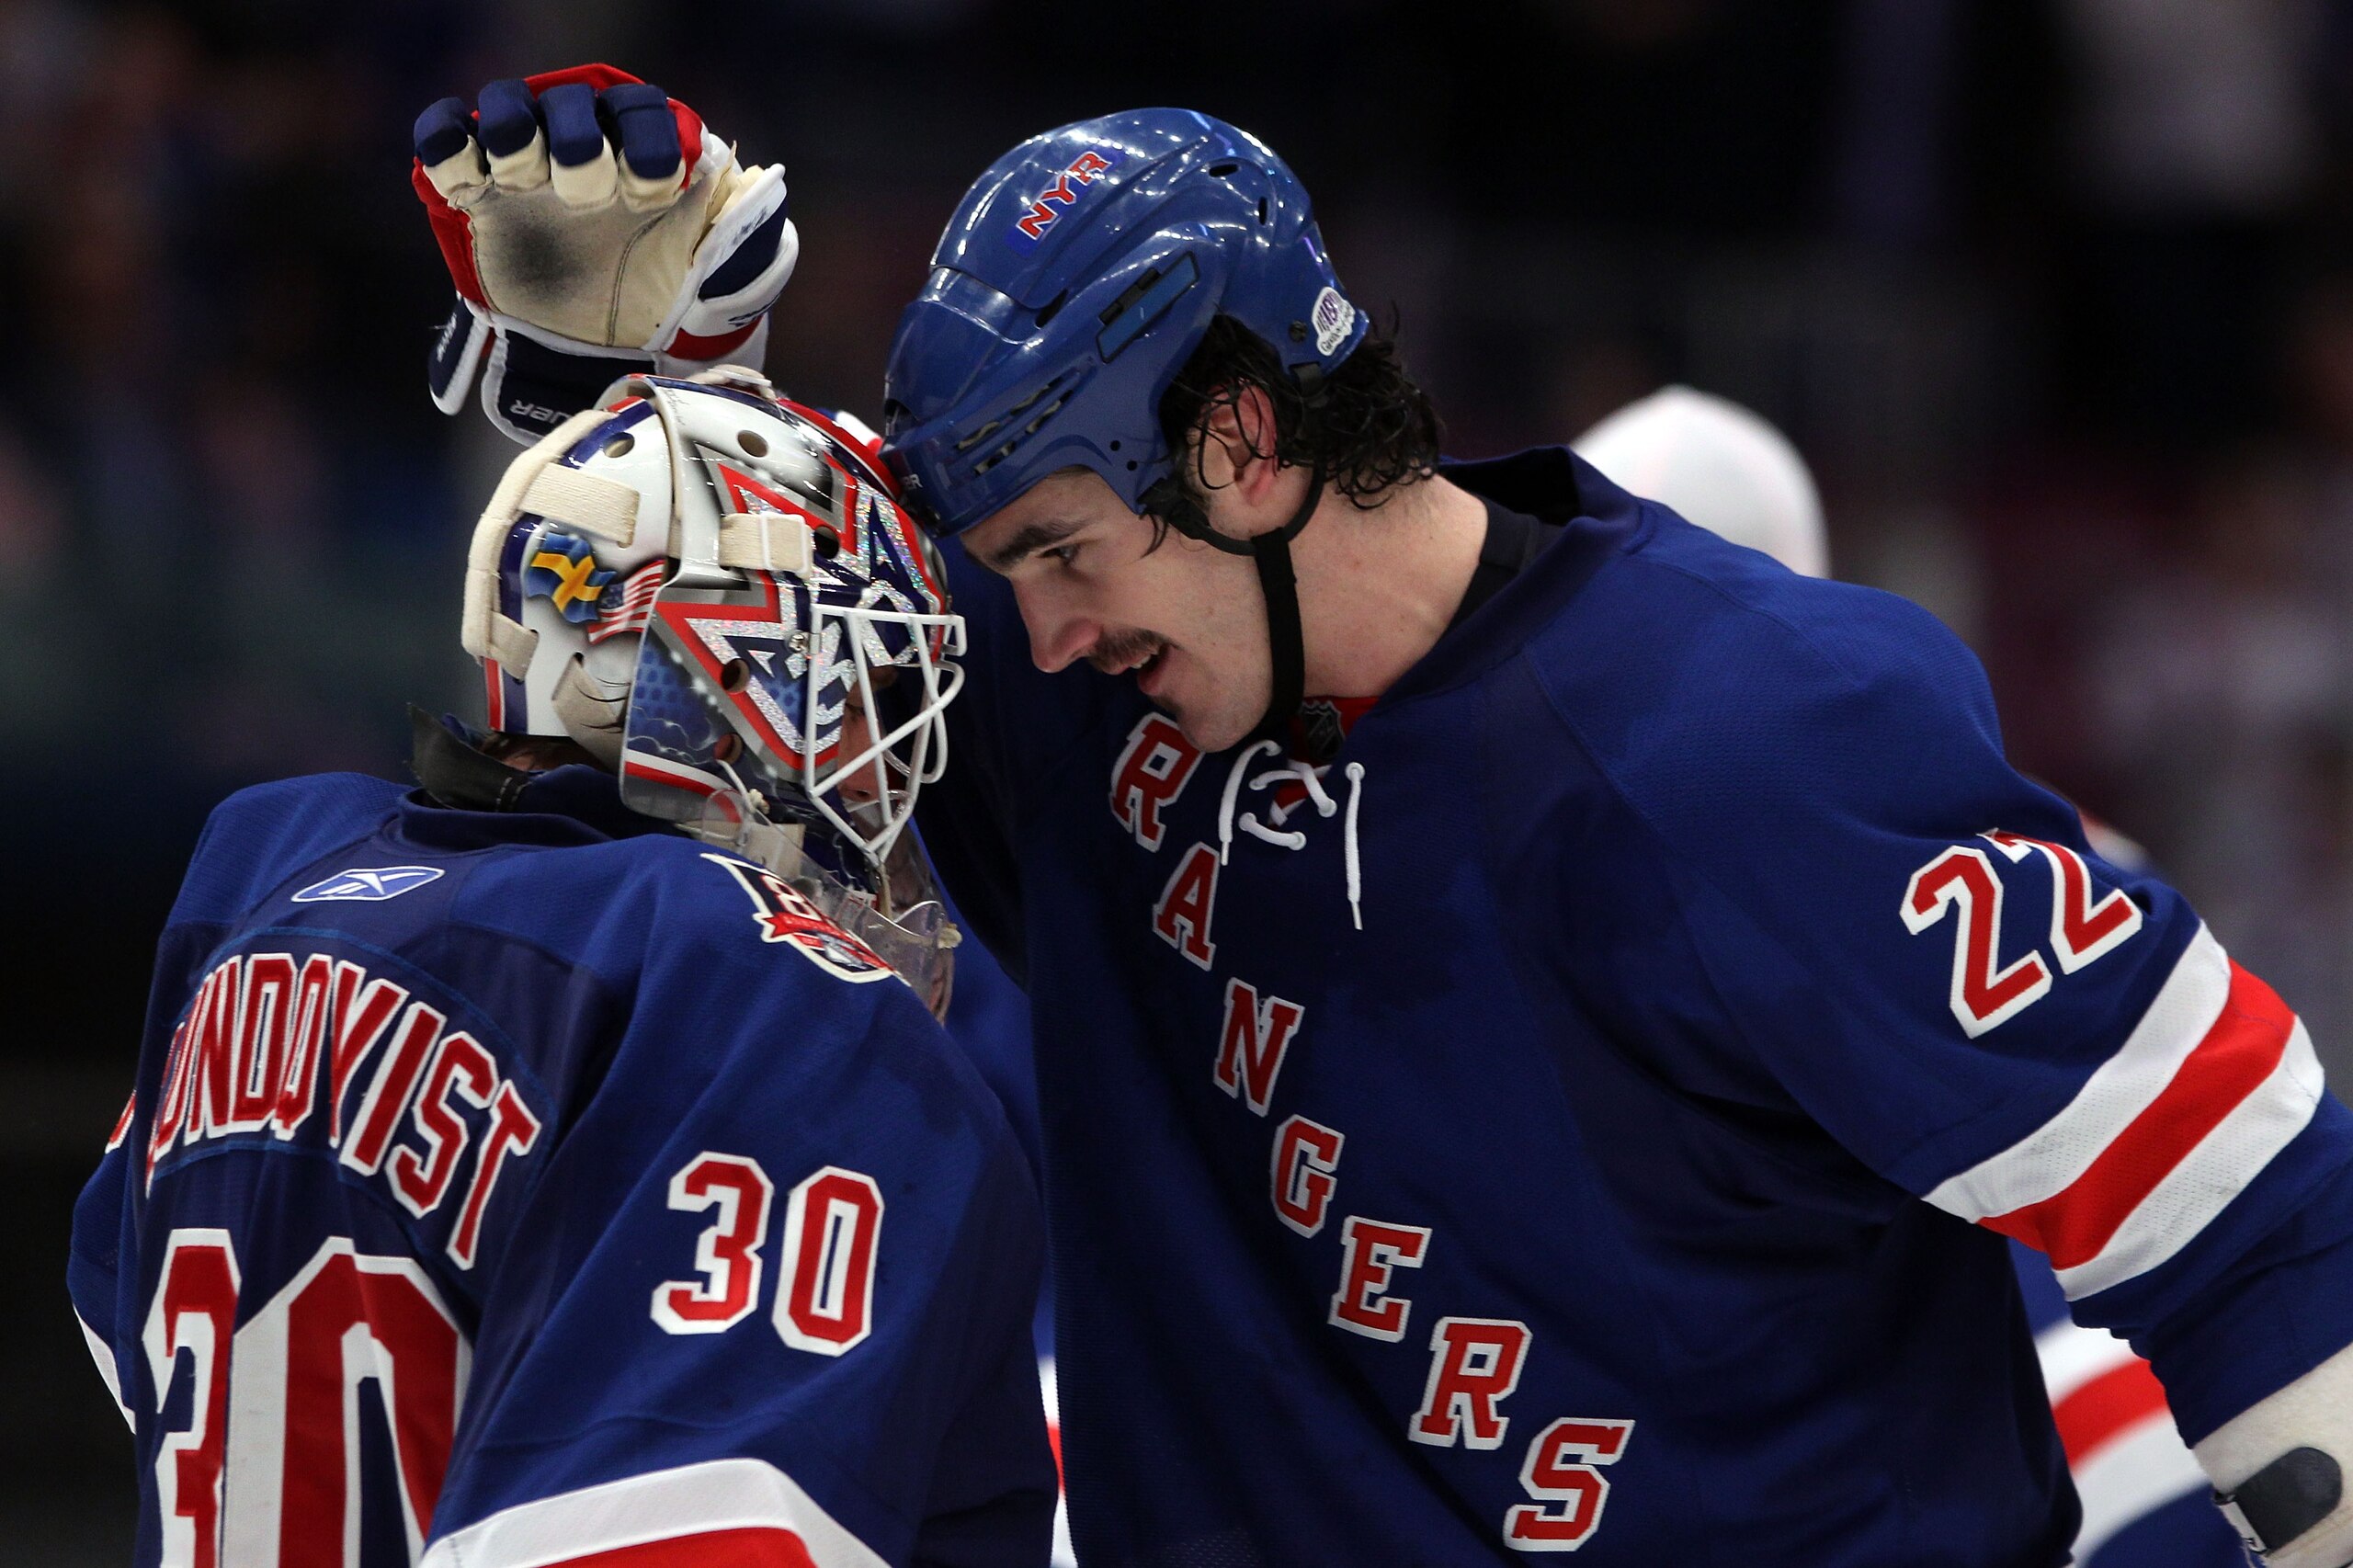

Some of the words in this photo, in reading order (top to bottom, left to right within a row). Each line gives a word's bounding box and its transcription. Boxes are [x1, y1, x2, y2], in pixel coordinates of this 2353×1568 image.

[1016, 152, 1112, 240] NYR
[509, 399, 574, 424] UER
[1899, 827, 2143, 1039] 22
[1109, 712, 1635, 1552] RANGERS
[650, 1151, 885, 1358] 30
[142, 1228, 474, 1568] 30
